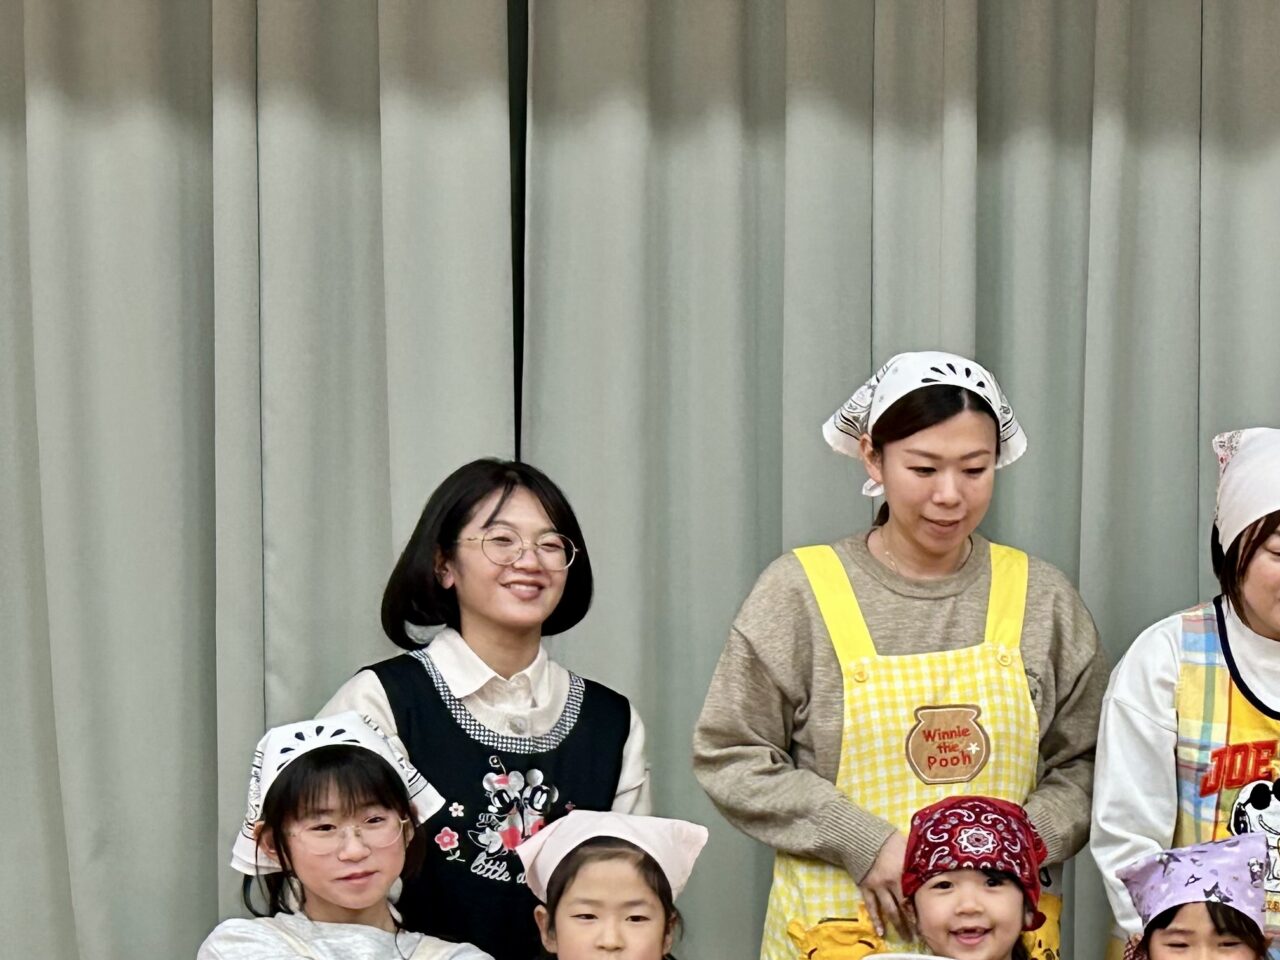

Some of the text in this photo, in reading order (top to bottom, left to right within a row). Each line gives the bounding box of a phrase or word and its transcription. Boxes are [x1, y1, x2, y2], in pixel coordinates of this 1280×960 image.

[922, 725, 971, 742] Winnie
[937, 742, 960, 754] the
[927, 750, 972, 771] Pooh
[1200, 740, 1279, 798] JOE
[470, 851, 511, 882] little
